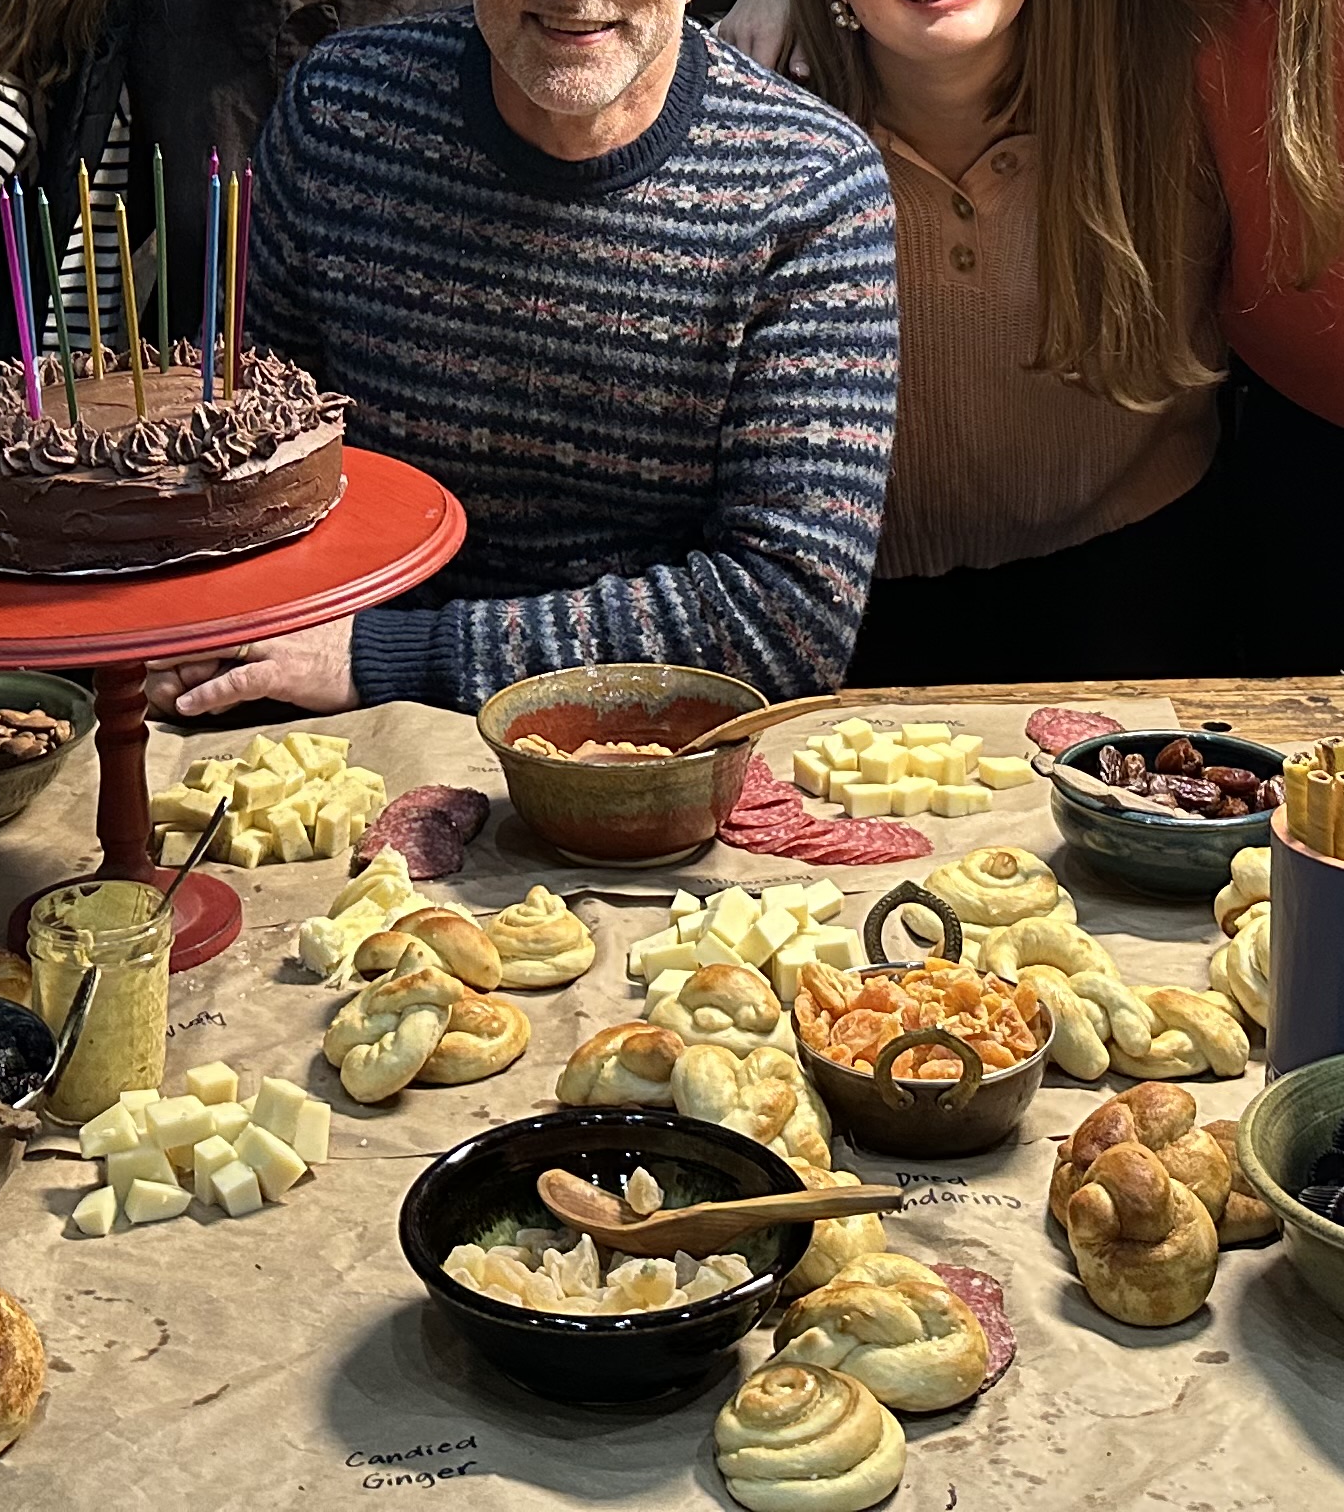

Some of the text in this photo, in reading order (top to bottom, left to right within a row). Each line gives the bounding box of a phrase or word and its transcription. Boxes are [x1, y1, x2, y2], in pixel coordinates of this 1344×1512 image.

[895, 1169, 969, 1190] Dried
[345, 1432, 480, 1471] Candied
[361, 1458, 479, 1491] Ginger
